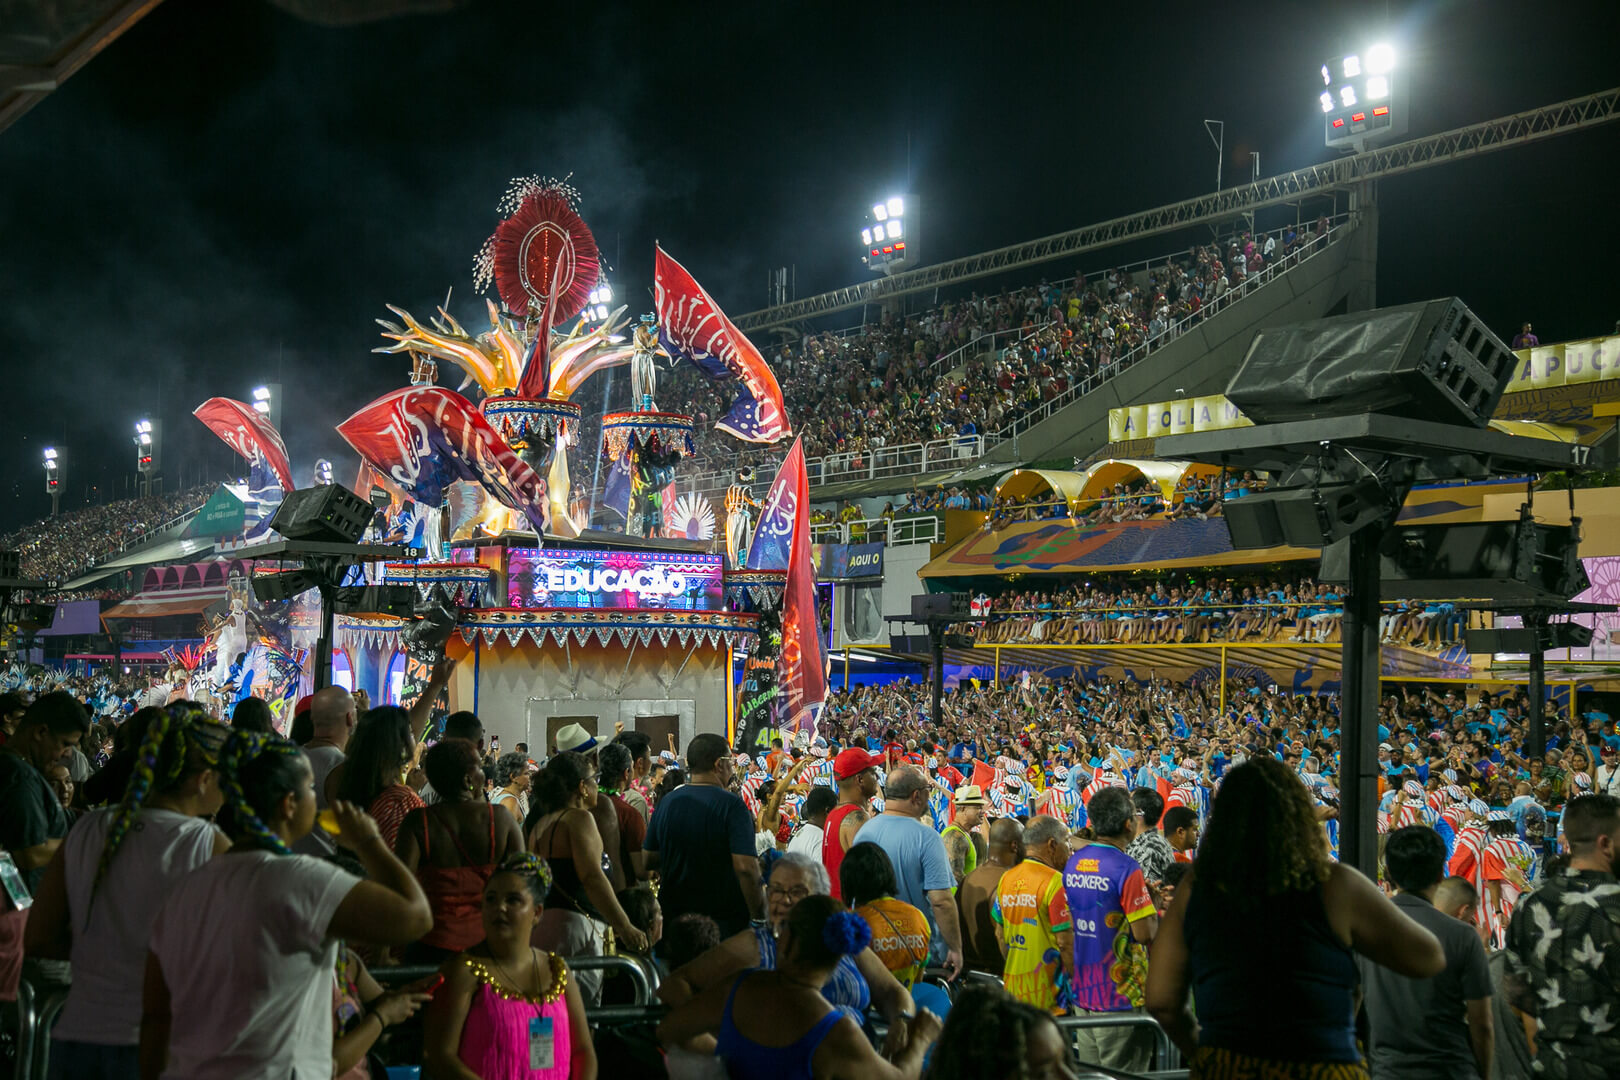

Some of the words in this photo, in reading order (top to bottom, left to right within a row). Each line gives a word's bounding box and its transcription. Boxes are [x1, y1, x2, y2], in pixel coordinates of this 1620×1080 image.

[1124, 415, 1135, 433] A
[1147, 405, 1212, 431] FOLIA
[1571, 445, 1591, 465] 17
[403, 547, 418, 557] 18
[849, 553, 872, 567] AQUI
[47, 580, 57, 588] 19
[550, 564, 687, 598] EDUCAÇÃO
[1066, 873, 1110, 892] BOOKERS
